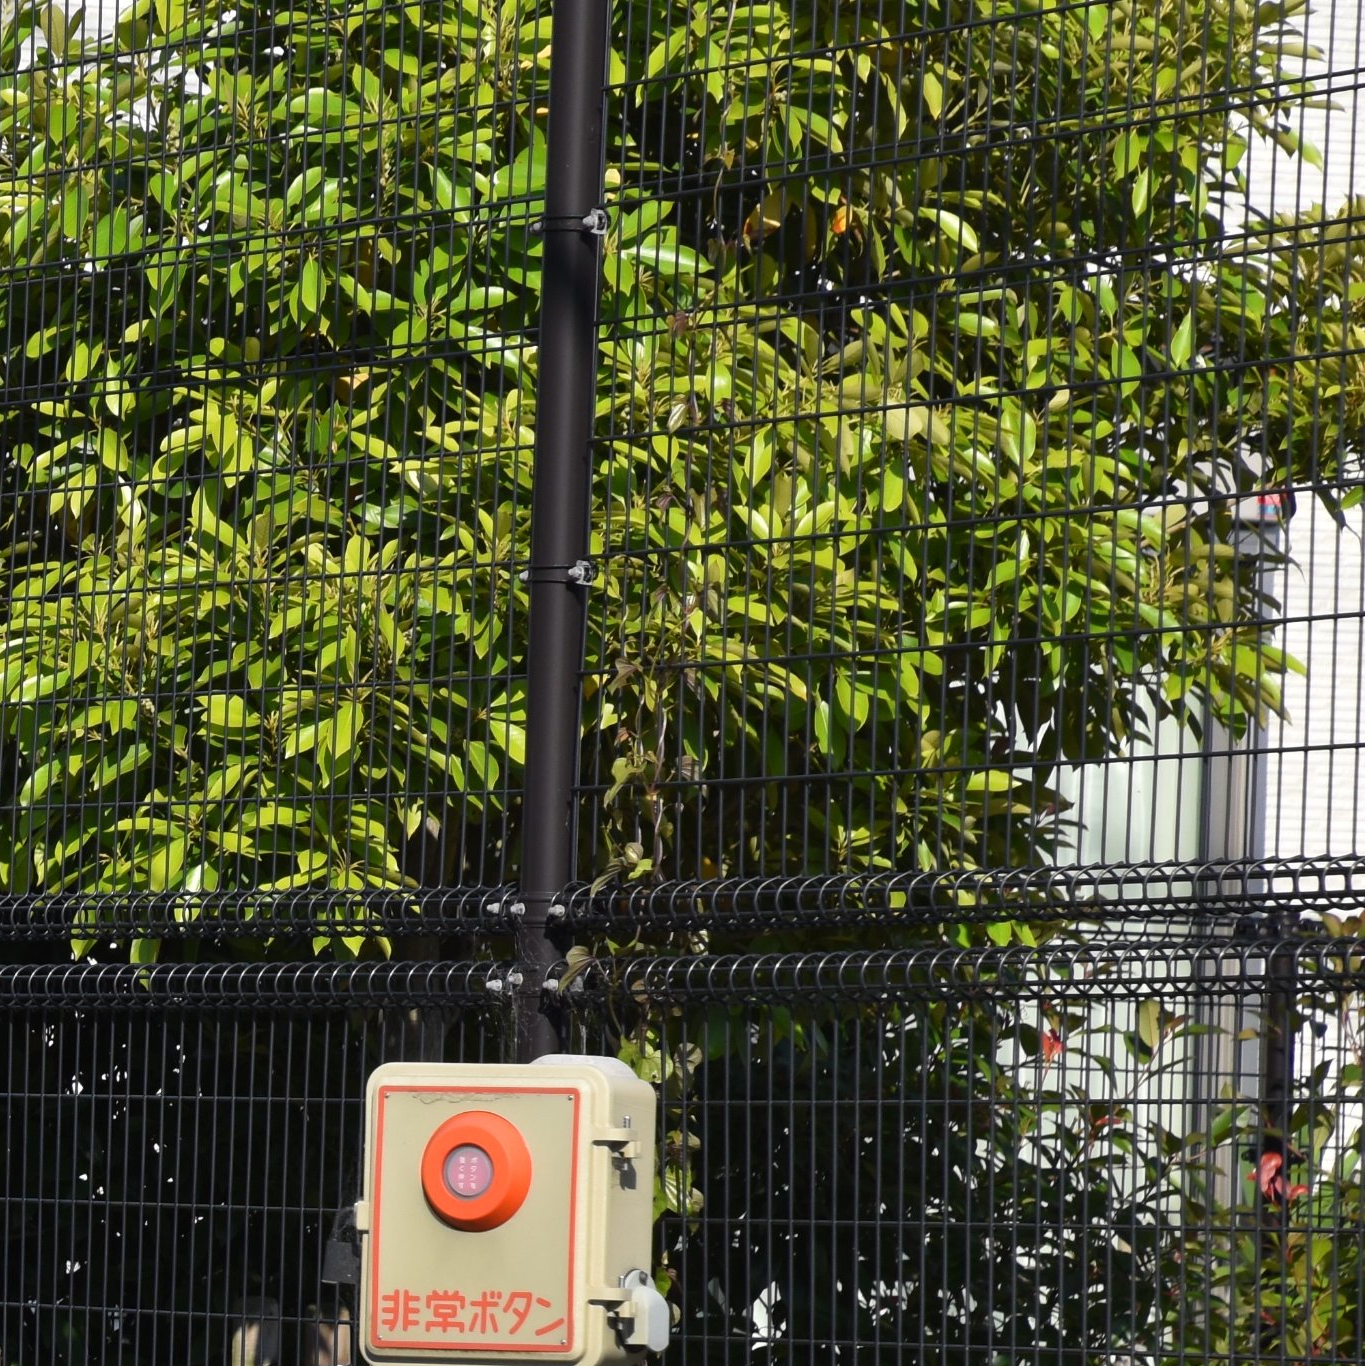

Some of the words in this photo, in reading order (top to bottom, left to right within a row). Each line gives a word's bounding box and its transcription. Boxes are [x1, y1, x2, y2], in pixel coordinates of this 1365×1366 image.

[381, 1288, 565, 1337] 非常ボタン
